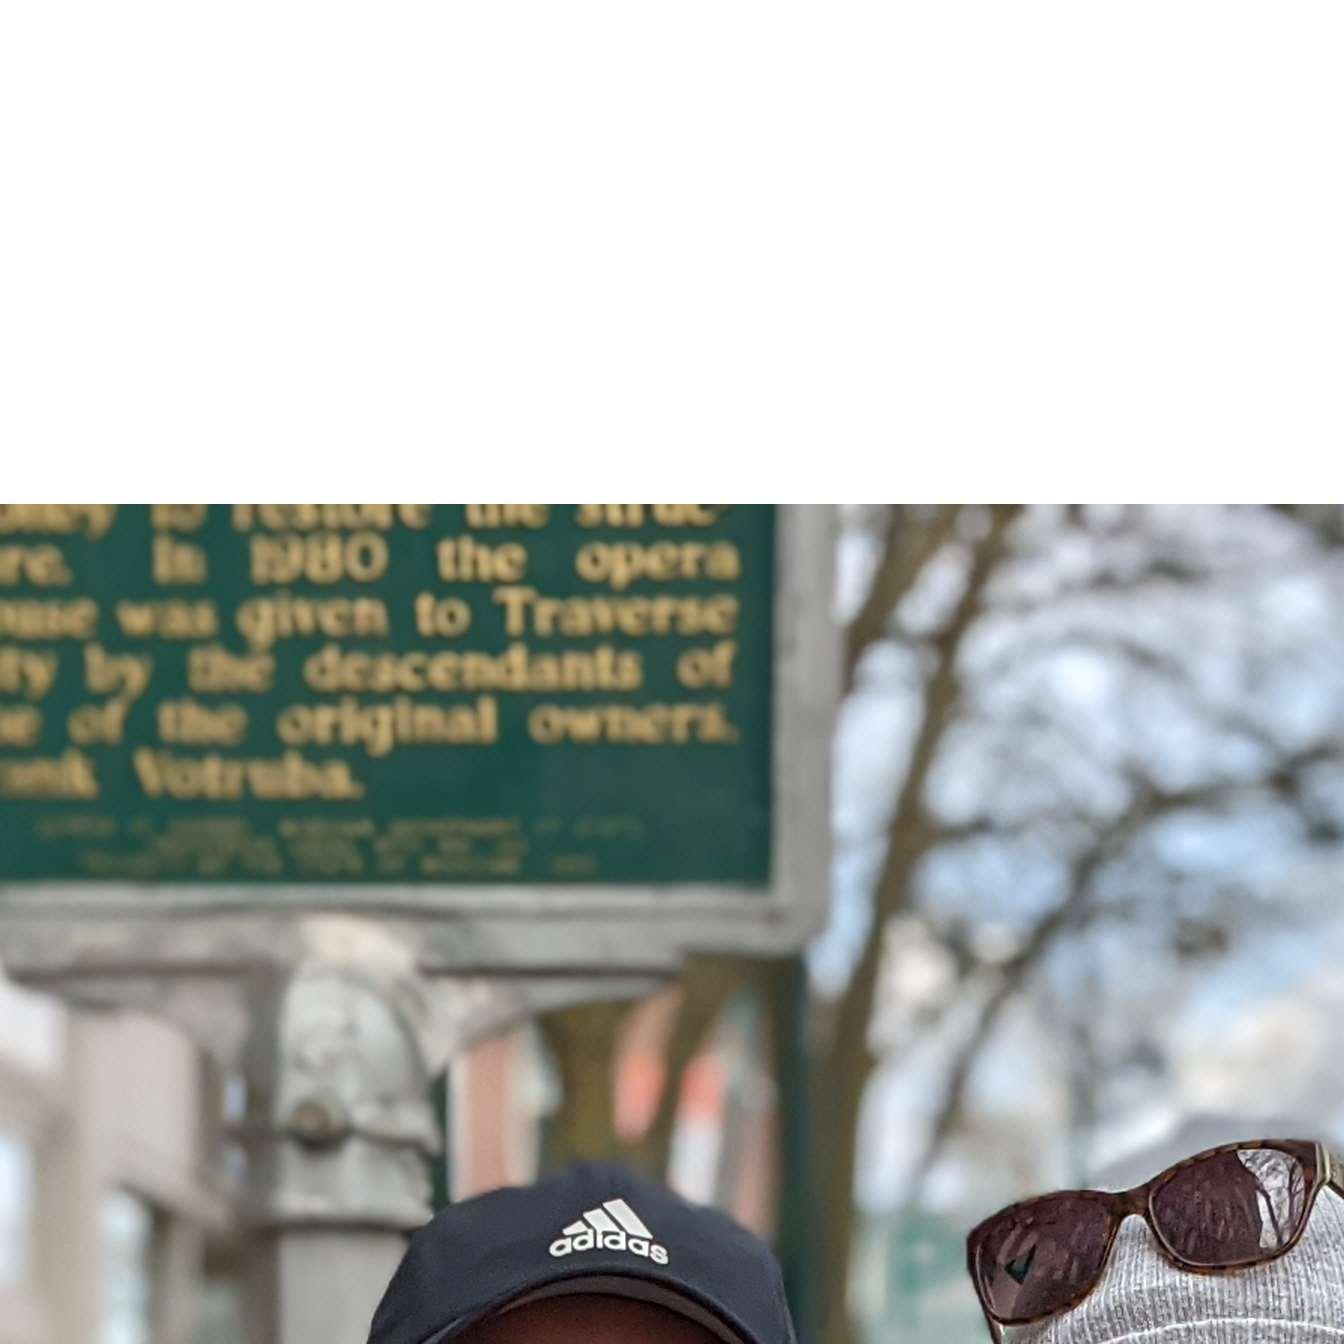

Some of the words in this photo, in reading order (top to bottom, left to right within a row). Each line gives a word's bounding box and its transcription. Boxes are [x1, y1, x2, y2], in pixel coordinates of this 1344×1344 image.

[437, 535, 527, 582] the
[575, 541, 740, 589] opera
[117, 600, 219, 638] was
[236, 592, 389, 652] given
[415, 592, 471, 637] to
[493, 586, 739, 638] Traverse
[84, 641, 153, 701] by
[188, 643, 275, 692] the
[304, 642, 643, 692] descendants
[677, 642, 737, 688] of
[68, 698, 126, 745] of
[159, 697, 248, 745] the
[276, 695, 498, 757] original
[549, 1229, 668, 1265] adidas
